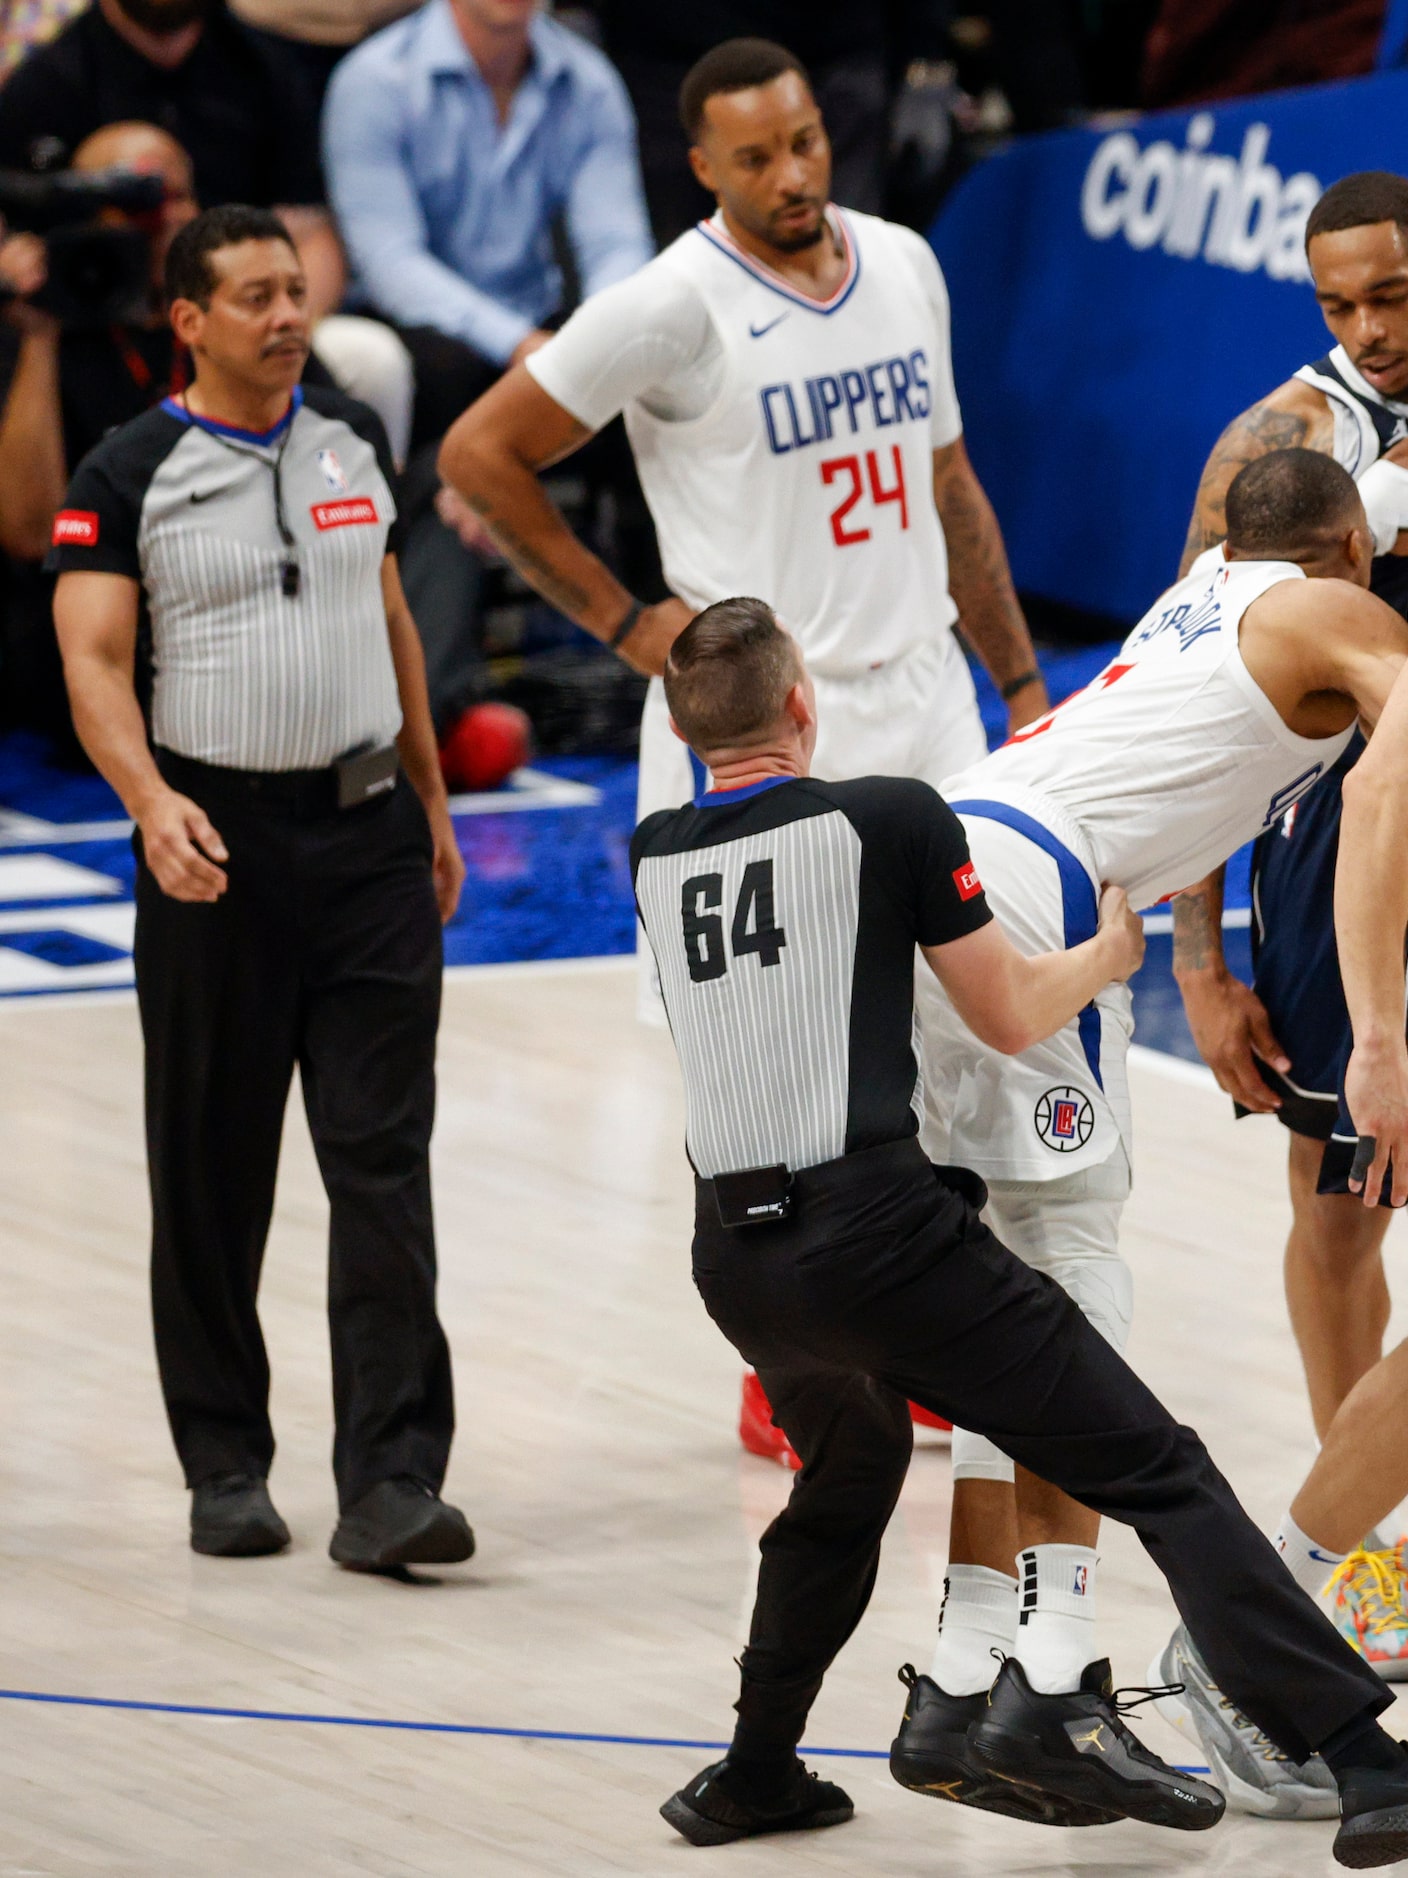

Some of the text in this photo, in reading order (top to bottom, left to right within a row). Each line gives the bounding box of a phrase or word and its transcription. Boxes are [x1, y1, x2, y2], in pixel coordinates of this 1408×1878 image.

[1081, 111, 1319, 285] coinba
[760, 349, 933, 455] CLIPPERS
[820, 444, 909, 547] 24
[682, 858, 786, 983] 64
